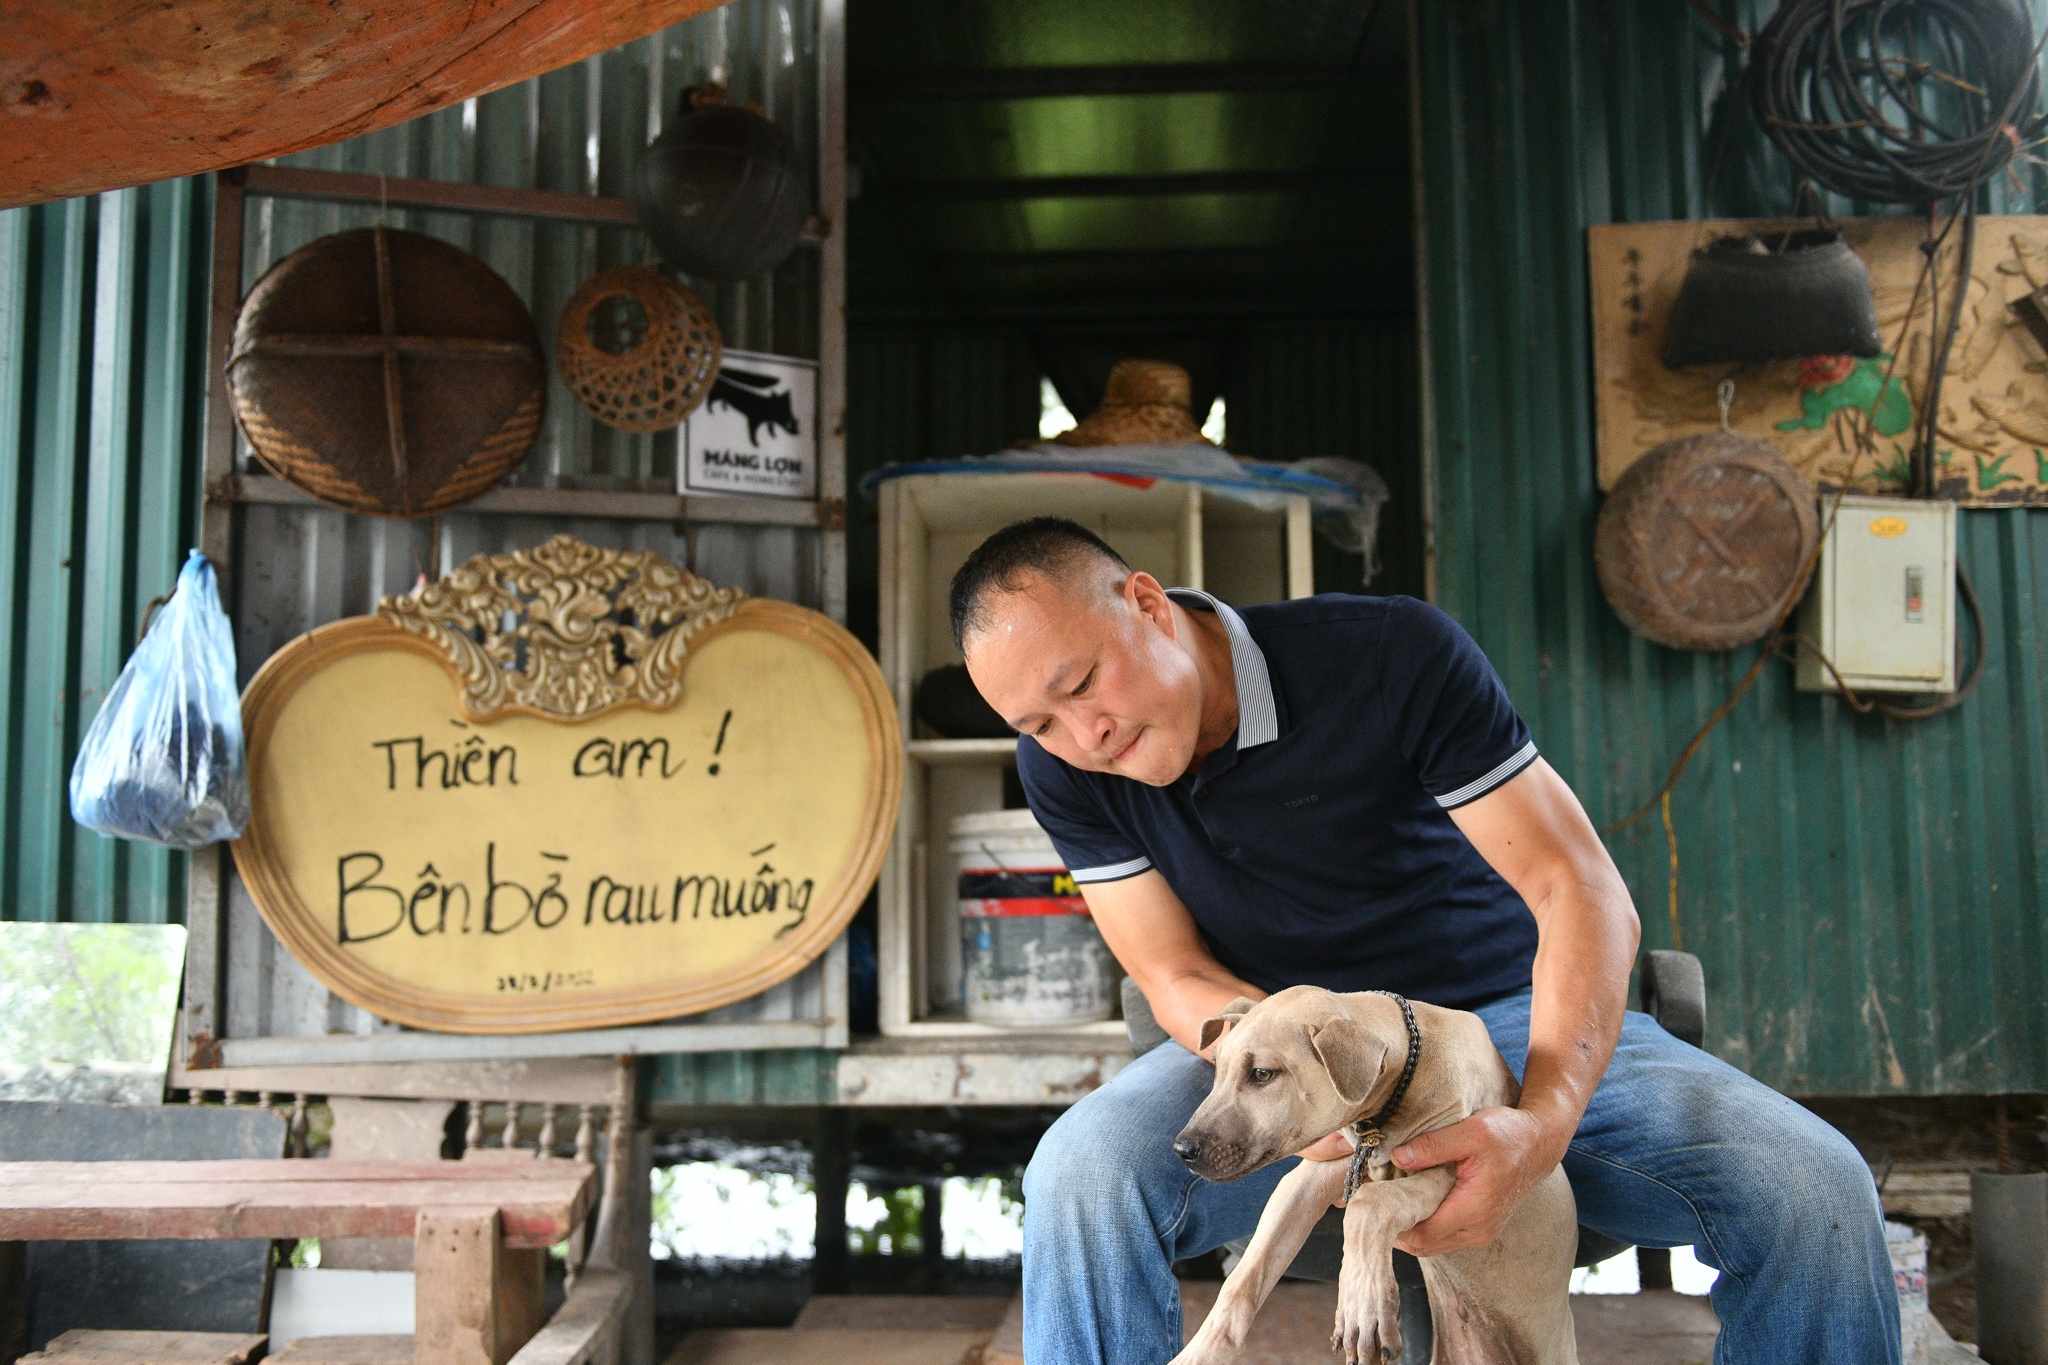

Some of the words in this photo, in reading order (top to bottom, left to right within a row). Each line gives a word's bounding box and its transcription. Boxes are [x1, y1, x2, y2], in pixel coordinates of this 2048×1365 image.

[337, 851, 472, 944] Bên
[584, 873, 661, 926] rau
[671, 843, 815, 939] muống
